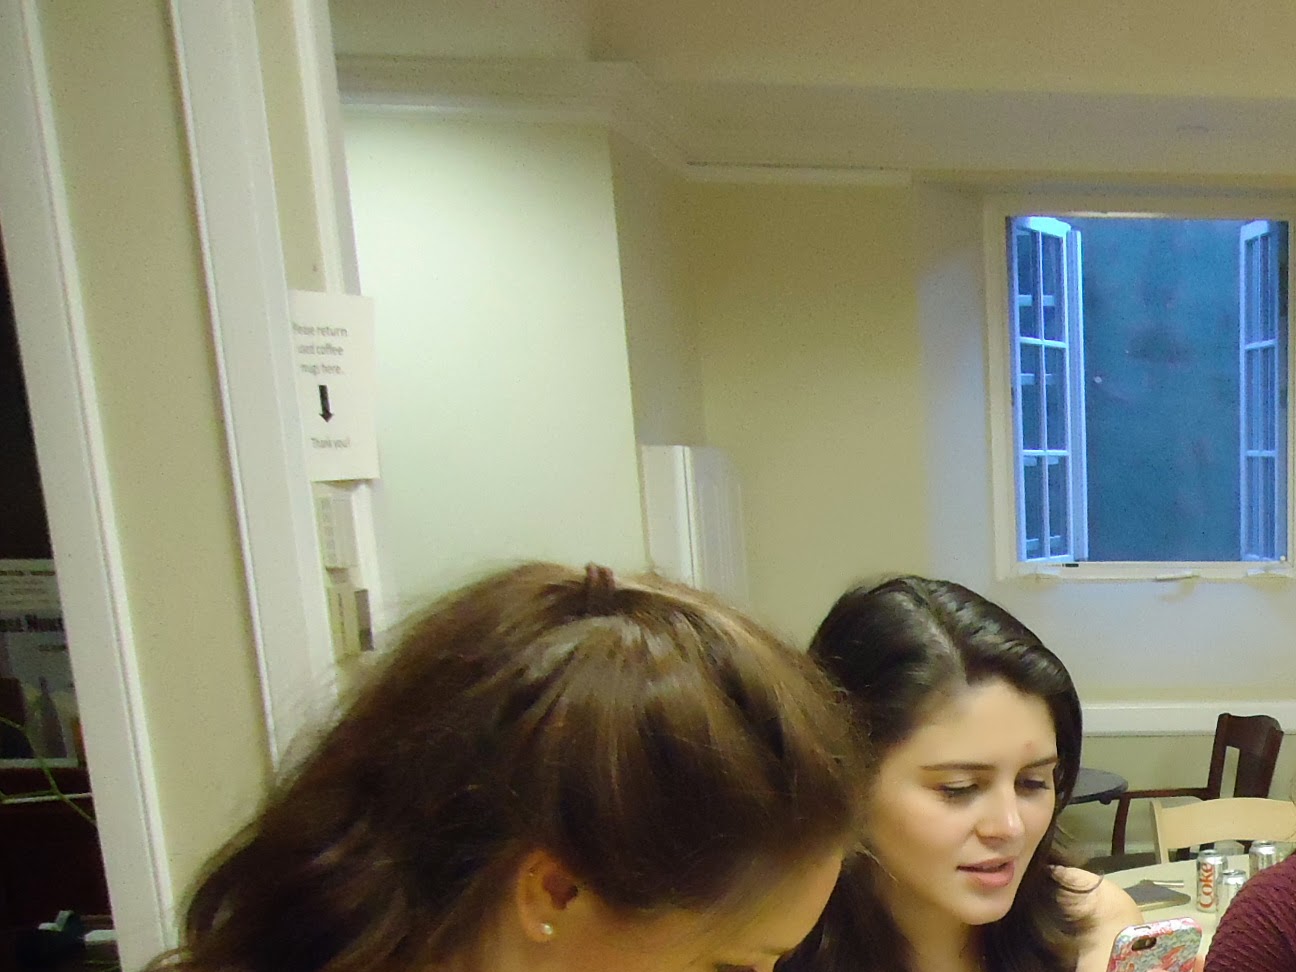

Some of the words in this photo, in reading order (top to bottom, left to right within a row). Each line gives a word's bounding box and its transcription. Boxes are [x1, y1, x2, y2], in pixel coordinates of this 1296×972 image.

[316, 326, 348, 337] return
[316, 342, 344, 356] coffee
[1200, 862, 1215, 909] Coke
